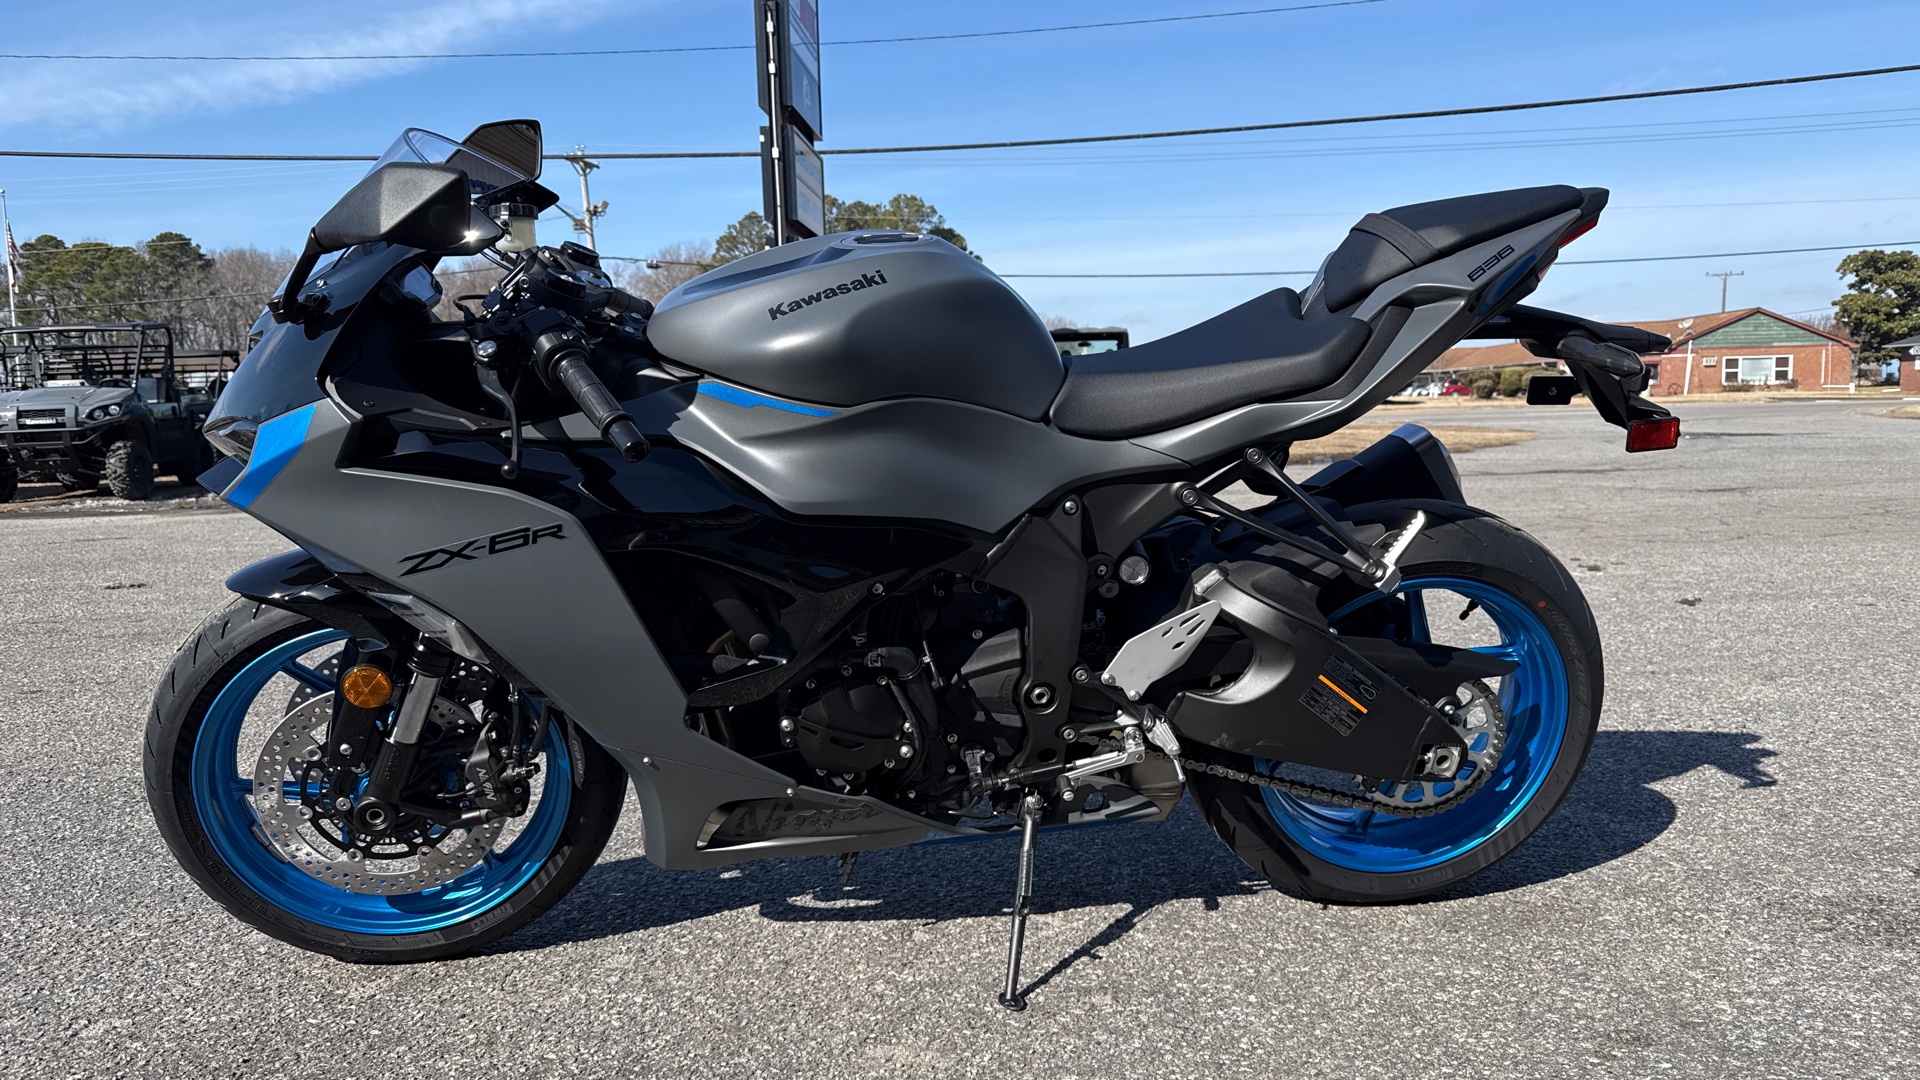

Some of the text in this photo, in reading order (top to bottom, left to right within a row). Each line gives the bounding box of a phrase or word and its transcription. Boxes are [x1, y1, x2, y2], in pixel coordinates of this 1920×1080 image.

[1467, 244, 1515, 282] 636
[767, 269, 888, 321] Kawasaki
[397, 523, 568, 577] ZX-6R
[193, 651, 230, 692] ROSSO
[470, 902, 514, 932] PIRELLI
